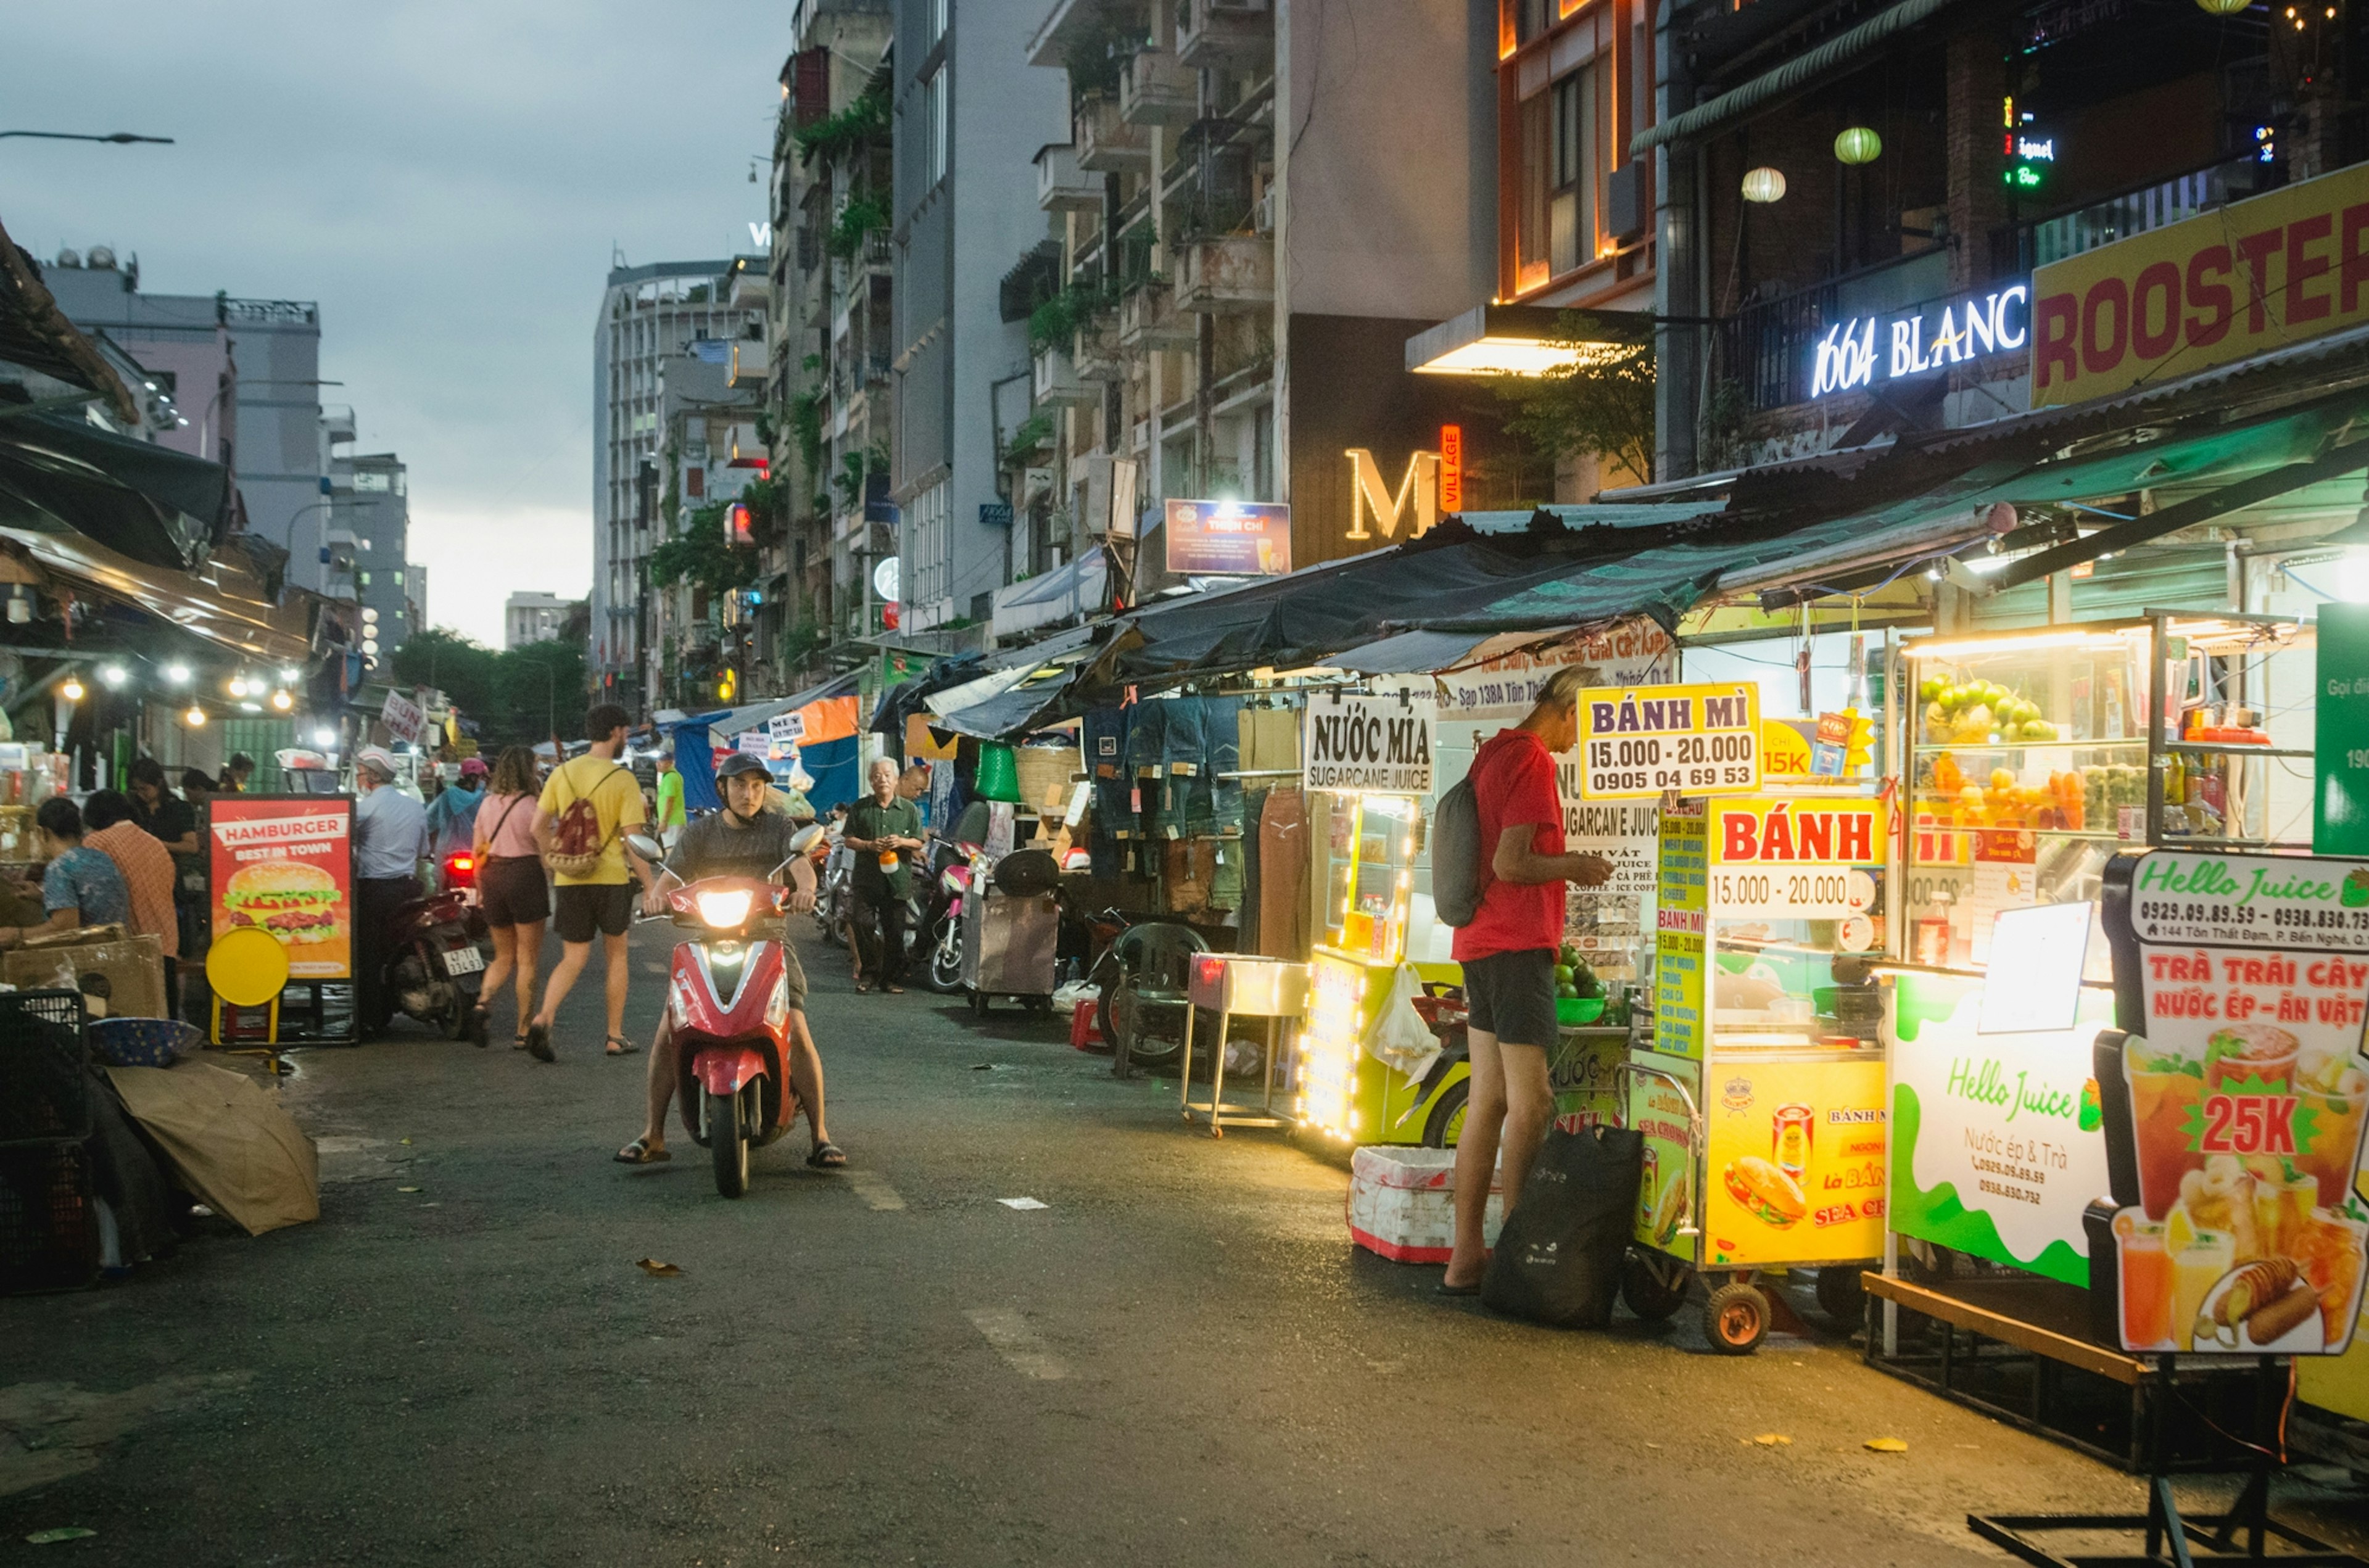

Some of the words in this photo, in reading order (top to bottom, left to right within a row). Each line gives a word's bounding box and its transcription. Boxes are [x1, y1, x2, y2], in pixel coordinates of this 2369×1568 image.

[2019, 136, 2054, 162] iguel
[1812, 316, 1879, 398] 1664
[1890, 286, 2026, 378] BLANC
[1445, 433, 1457, 503] VILLAGE
[1344, 448, 1442, 539] M
[1479, 683, 1503, 704] 138A
[1527, 675, 1547, 701] Thấ
[2327, 679, 2350, 699] Gọi
[1592, 694, 1692, 733] BÁNH
[1705, 688, 1748, 728] MÌ
[1313, 702, 1381, 763] NƯỚC
[1386, 704, 1430, 765] MÍA
[1590, 740, 1660, 769] 15.000
[1678, 735, 1751, 764] 20.000
[1764, 751, 1807, 774] 15K
[2346, 748, 2369, 769] 190
[1310, 765, 1388, 788] SUGARCANE
[1392, 769, 1428, 790] JUICE
[1594, 772, 1647, 790] 0905
[1656, 770, 1682, 787] 04
[1690, 768, 1716, 786] 69
[1724, 766, 1750, 784] 53
[1563, 807, 1627, 836] UGARCANE
[1631, 807, 1658, 836] JUIC
[1666, 803, 1703, 815] EAD
[225, 819, 339, 842] HAMBURGER
[1722, 803, 1872, 860] BÁNH
[234, 848, 270, 862] BEST
[271, 846, 287, 859] IN
[288, 841, 333, 856] TOWN
[1616, 884, 1632, 892] ICE
[1634, 884, 1657, 892] COFF
[1713, 875, 1769, 904] 15.000
[1788, 875, 1846, 904] 20.000
[2138, 859, 2241, 895] Hello
[2234, 867, 2338, 907] Juice
[1658, 905, 1687, 930] BÁNH
[1691, 908, 1705, 933] MÌ
[2141, 901, 2255, 925] 0929.09.89.59
[2274, 907, 2369, 930] 0938.830.73
[2162, 926, 2181, 936] 144
[2186, 926, 2209, 938] Tôn
[2289, 930, 2313, 943] Bến
[2223, 954, 2297, 984] TRÁI
[2307, 956, 2368, 989] CÂY
[2153, 987, 2218, 1020] NƯỚC
[1947, 1057, 2010, 1107] Hello
[2005, 1071, 2076, 1123] Juice
[1831, 1106, 1875, 1123] BÁNH
[2201, 1095, 2299, 1154] 25K
[1850, 1142, 1880, 1153] NGON
[1964, 1126, 2003, 1156] Nước
[2006, 1134, 2024, 1166] ép
[2027, 1139, 2038, 1164] &
[2041, 1142, 2067, 1170] Trà
[1846, 1161, 1885, 1189] BÁN
[1978, 1158, 2046, 1185] 0929.09.89.59
[1979, 1179, 2041, 1205] 0938.830.732
[1814, 1203, 1857, 1226] SEA
